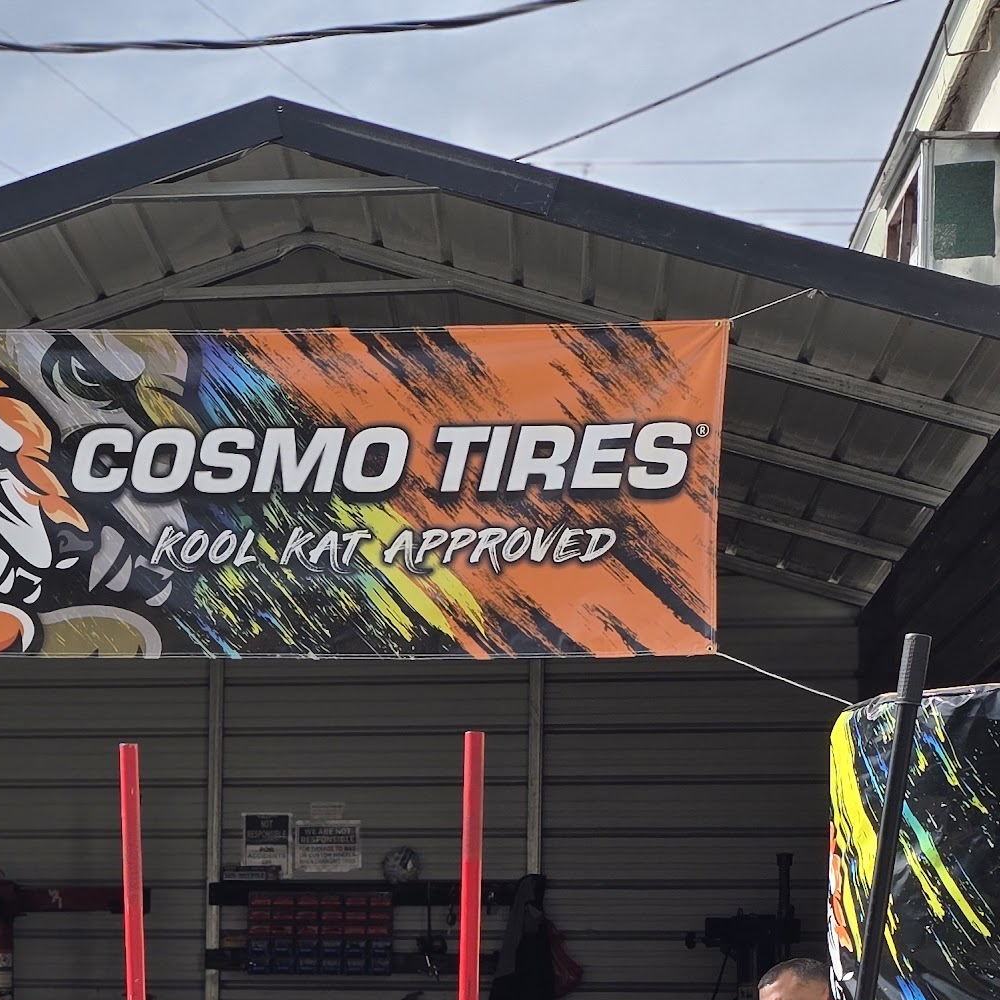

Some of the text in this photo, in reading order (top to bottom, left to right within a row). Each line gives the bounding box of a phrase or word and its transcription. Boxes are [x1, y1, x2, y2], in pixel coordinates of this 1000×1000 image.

[71, 426, 409, 494] COSMO
[151, 522, 618, 574] KOOL KAT APPROVED
[335, 827, 352, 835] NOT
